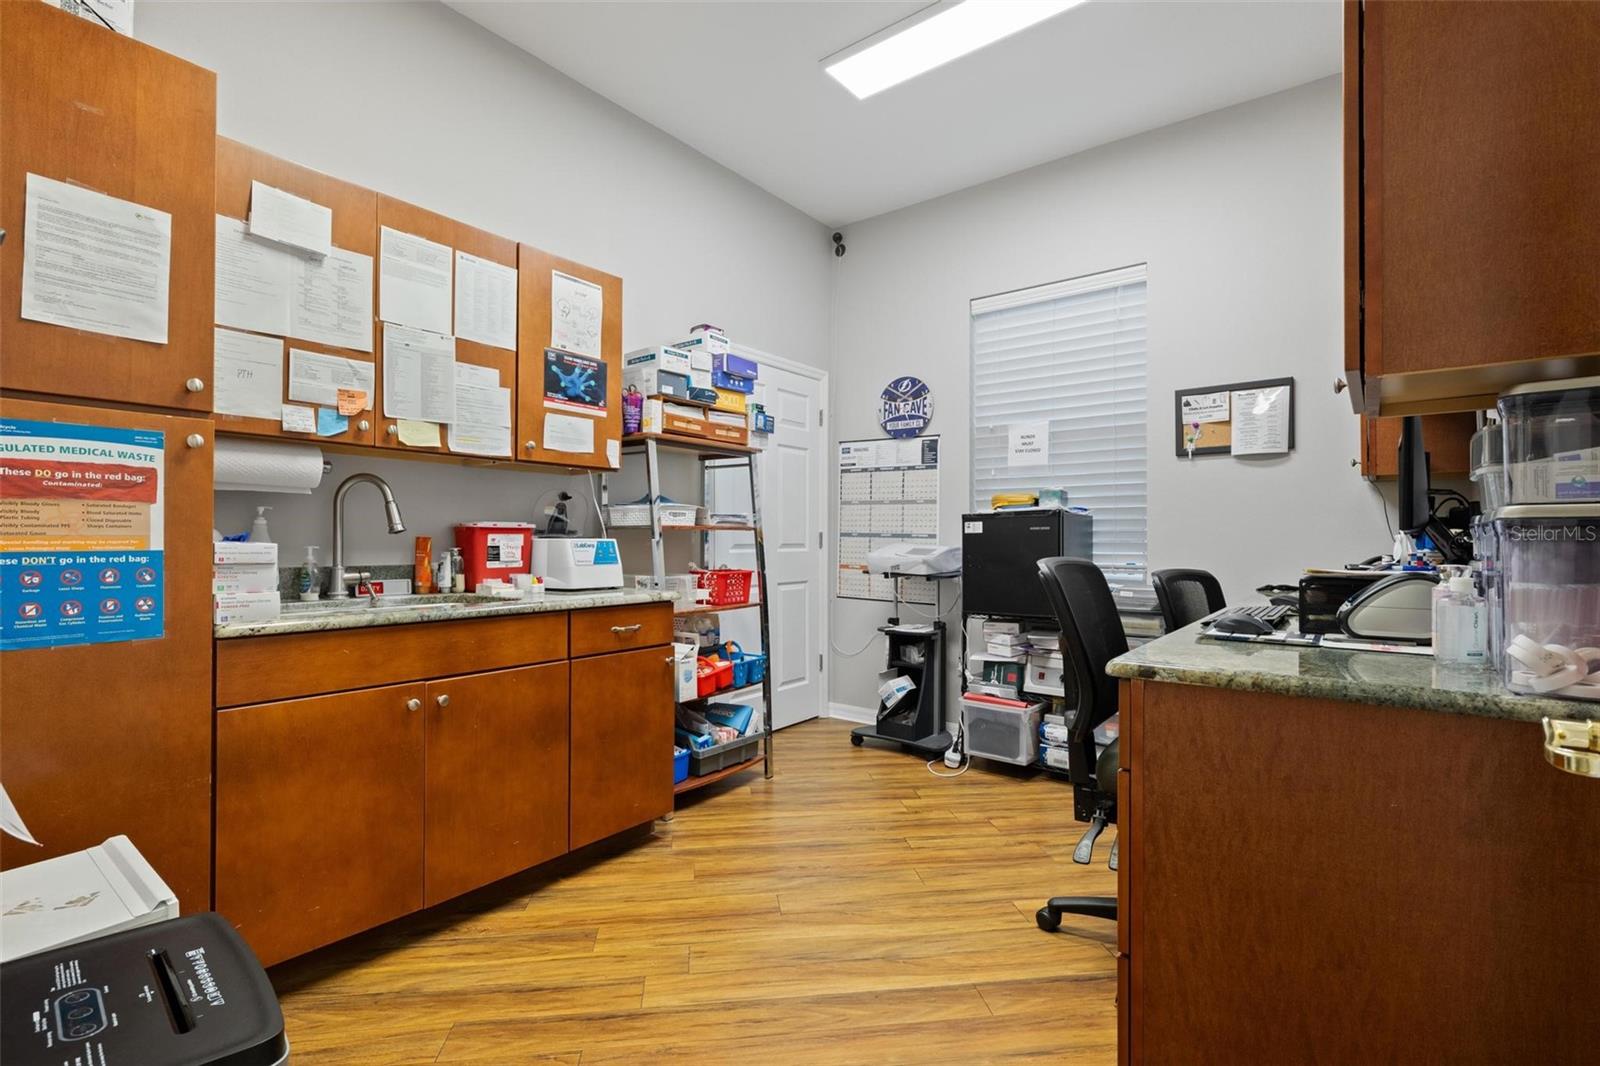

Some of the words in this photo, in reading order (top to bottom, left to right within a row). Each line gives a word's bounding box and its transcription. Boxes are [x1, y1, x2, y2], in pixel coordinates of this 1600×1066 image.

[883, 401, 900, 420] FAN
[59, 445, 114, 458] MEDICAL
[117, 450, 156, 463] WASTE
[0, 467, 31, 476] These
[34, 469, 51, 478] DO
[55, 471, 69, 480] go
[72, 471, 82, 479] in
[85, 471, 103, 480] the
[105, 472, 121, 481] red
[124, 473, 145, 483] bag:
[22, 556, 56, 565] DON'T
[59, 558, 73, 566] go
[76, 556, 86, 564] in
[89, 555, 106, 564] the
[109, 555, 126, 563] red
[128, 554, 149, 564] bag:
